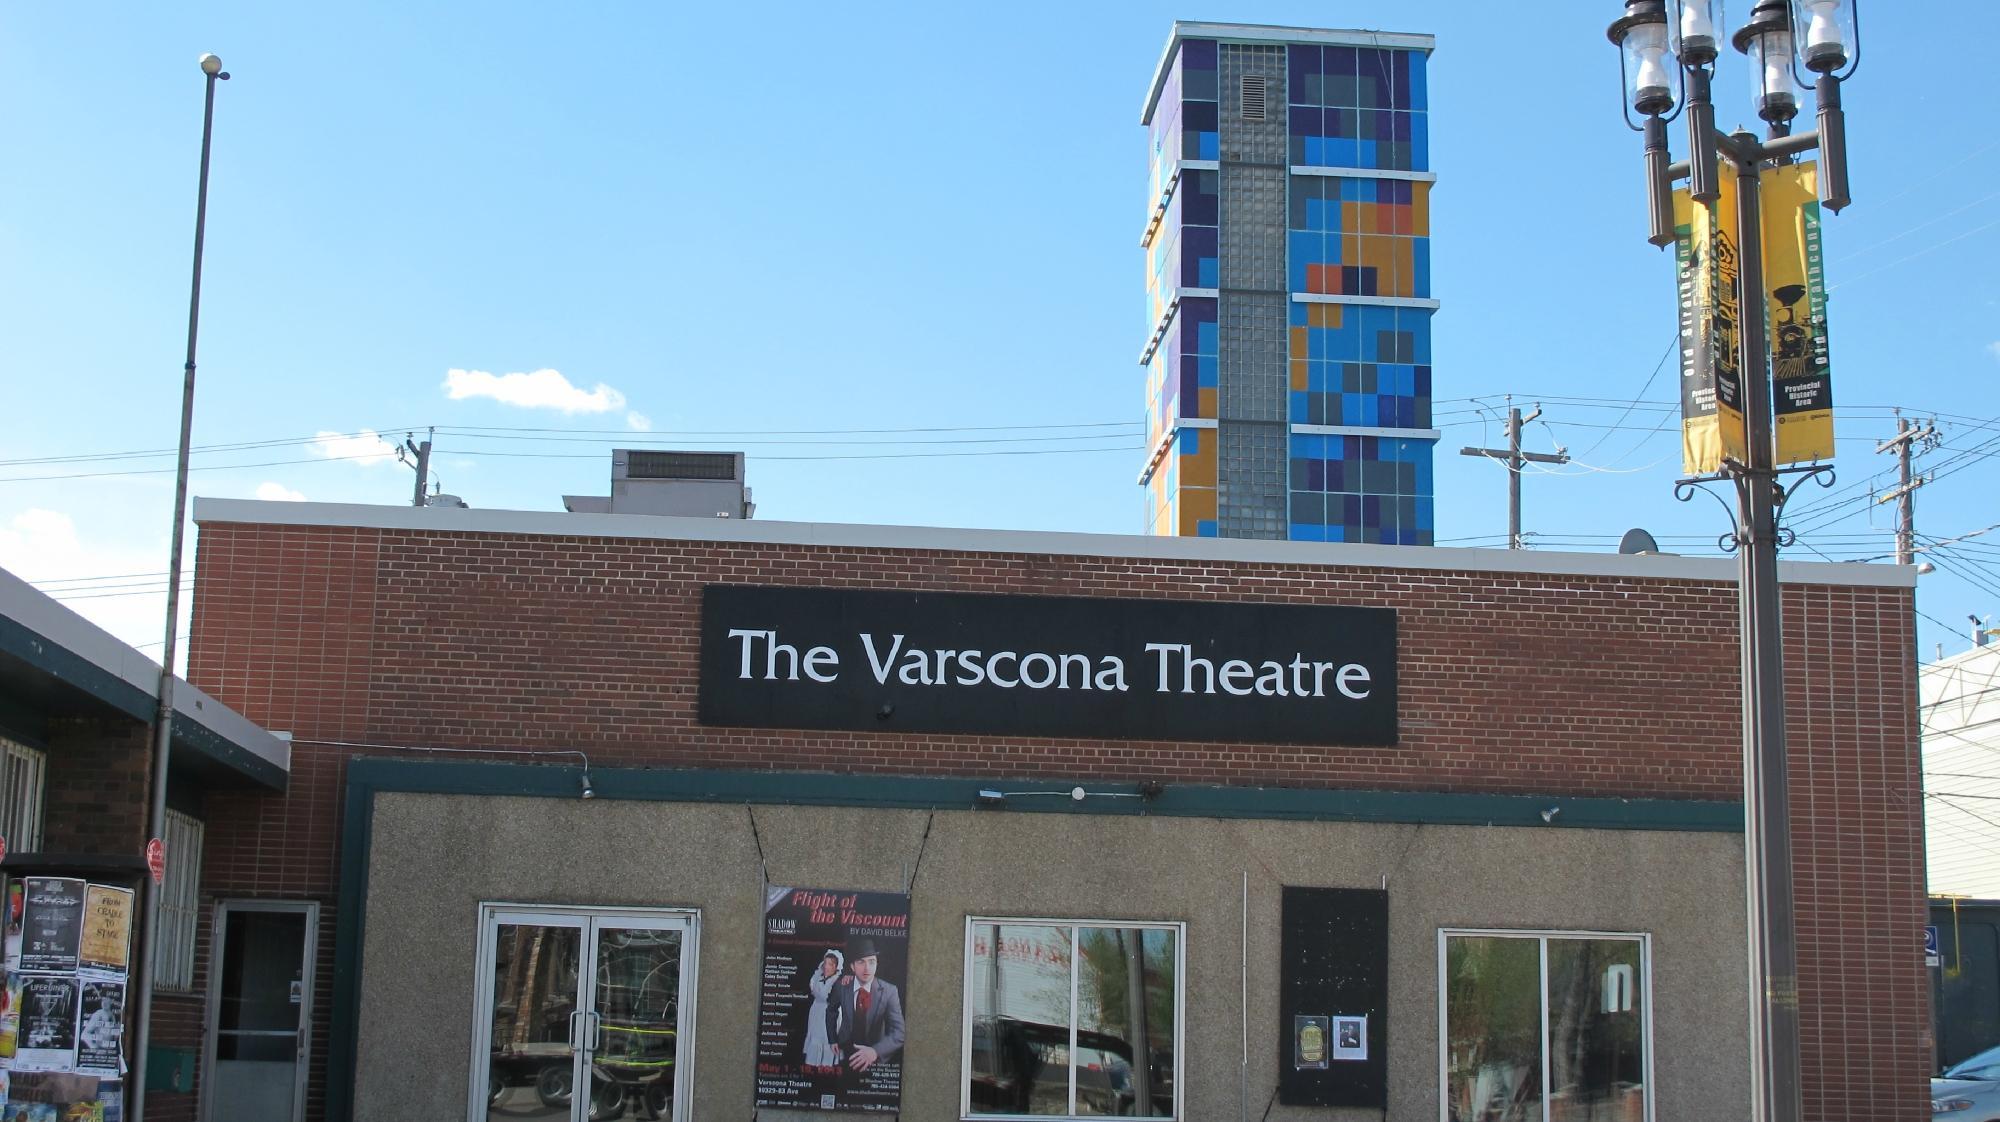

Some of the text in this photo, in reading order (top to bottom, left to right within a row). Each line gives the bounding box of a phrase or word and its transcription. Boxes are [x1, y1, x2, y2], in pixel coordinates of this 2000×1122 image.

[1806, 220, 1828, 365] Old Strathcona
[1680, 239, 1695, 377] Old Strathcona
[1691, 387, 1716, 398] Provinc
[1784, 381, 1821, 393] Provincial
[1789, 390, 1818, 400] Historic
[1795, 398, 1812, 407] Area
[728, 628, 1370, 699] The Varscona Theatre
[792, 891, 837, 909] Flight
[840, 894, 857, 908] of
[768, 919, 797, 929] SHADOW
[810, 909, 907, 928] the Viscount
[850, 927, 908, 937] BY DAVID BELKE
[758, 1063, 780, 1073] May
[788, 1080, 813, 1088] Theatre
